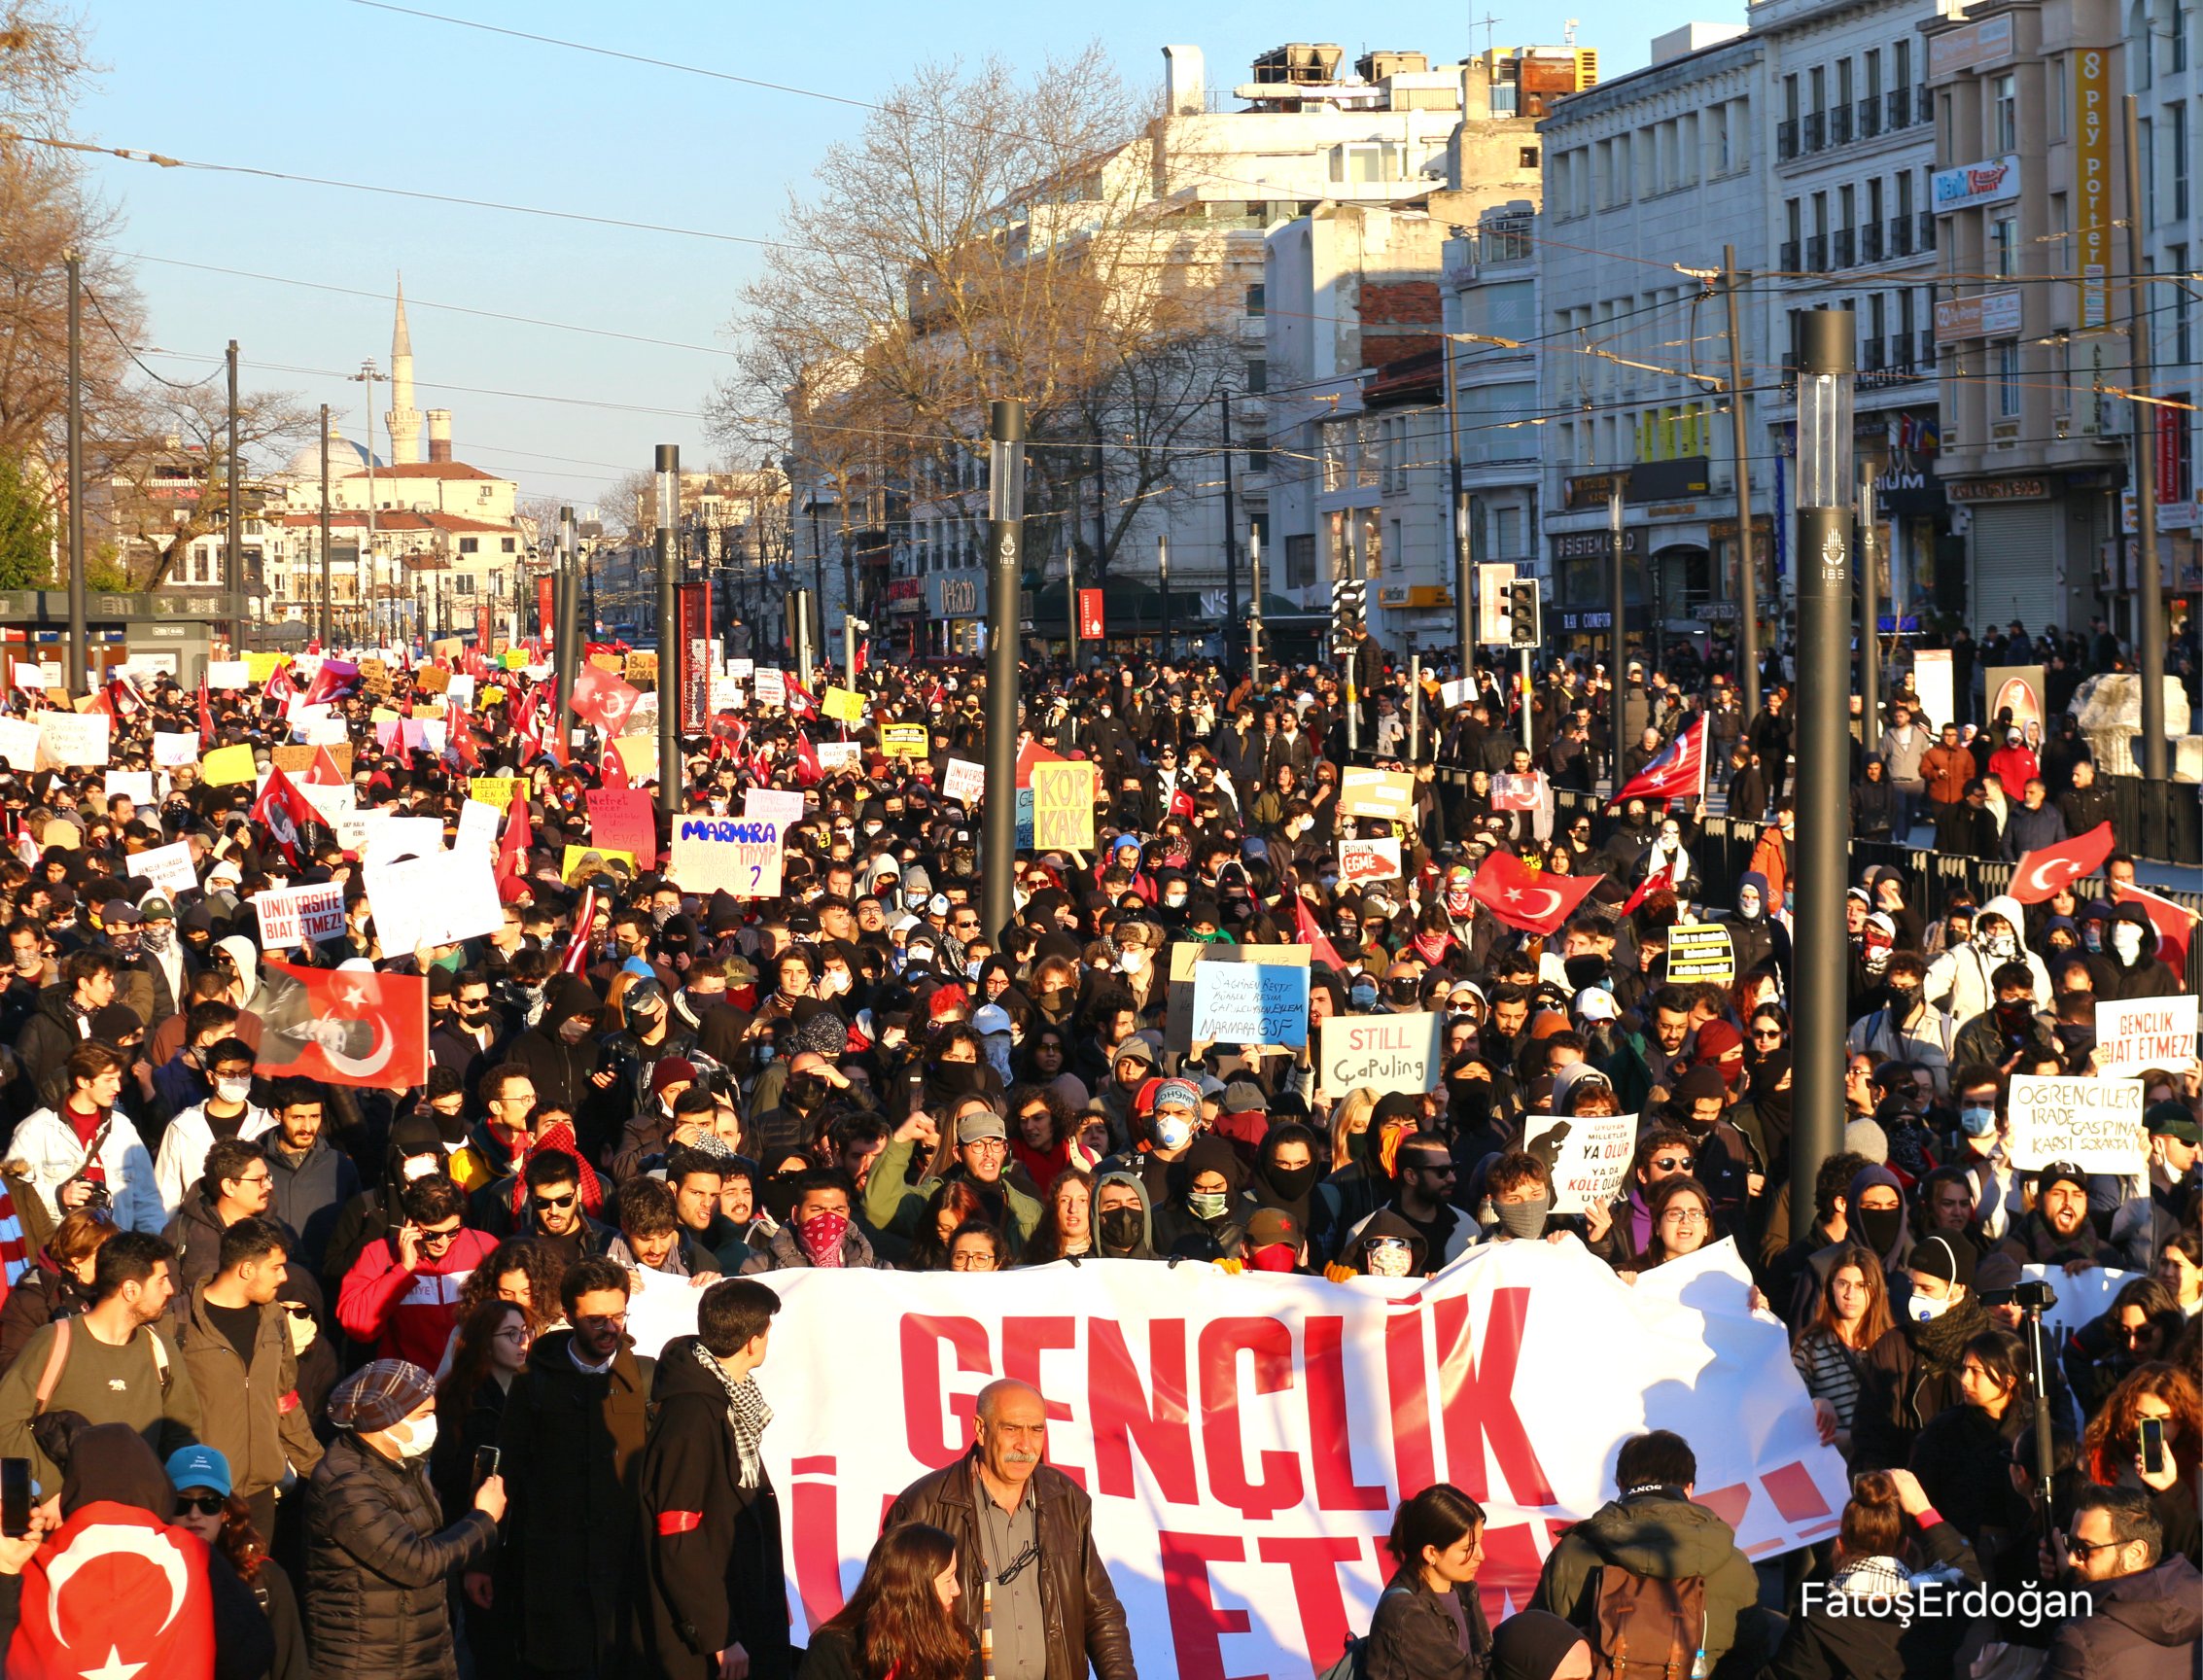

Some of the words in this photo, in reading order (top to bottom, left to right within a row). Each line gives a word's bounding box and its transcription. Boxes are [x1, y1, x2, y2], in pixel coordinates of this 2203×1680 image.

[1040, 768, 1089, 807] KOR
[681, 820, 777, 844] MARMARA
[262, 890, 341, 919] ÜNİVERSİTE
[298, 912, 342, 937] ETMEZ!
[1199, 1018, 1256, 1037] MARMARA
[1257, 1017, 1294, 1038] GSF
[1349, 1026, 1412, 1051] STILL
[2138, 1033, 2194, 1061] ETMEZ!
[1584, 1145, 1599, 1160] YA
[1567, 1176, 1600, 1191] KÖLE
[1602, 1174, 1624, 1191] OLARA
[1591, 1168, 1606, 1176] YA
[1609, 1167, 1619, 1175] DA
[900, 1286, 1558, 1521] GENÇLİK
